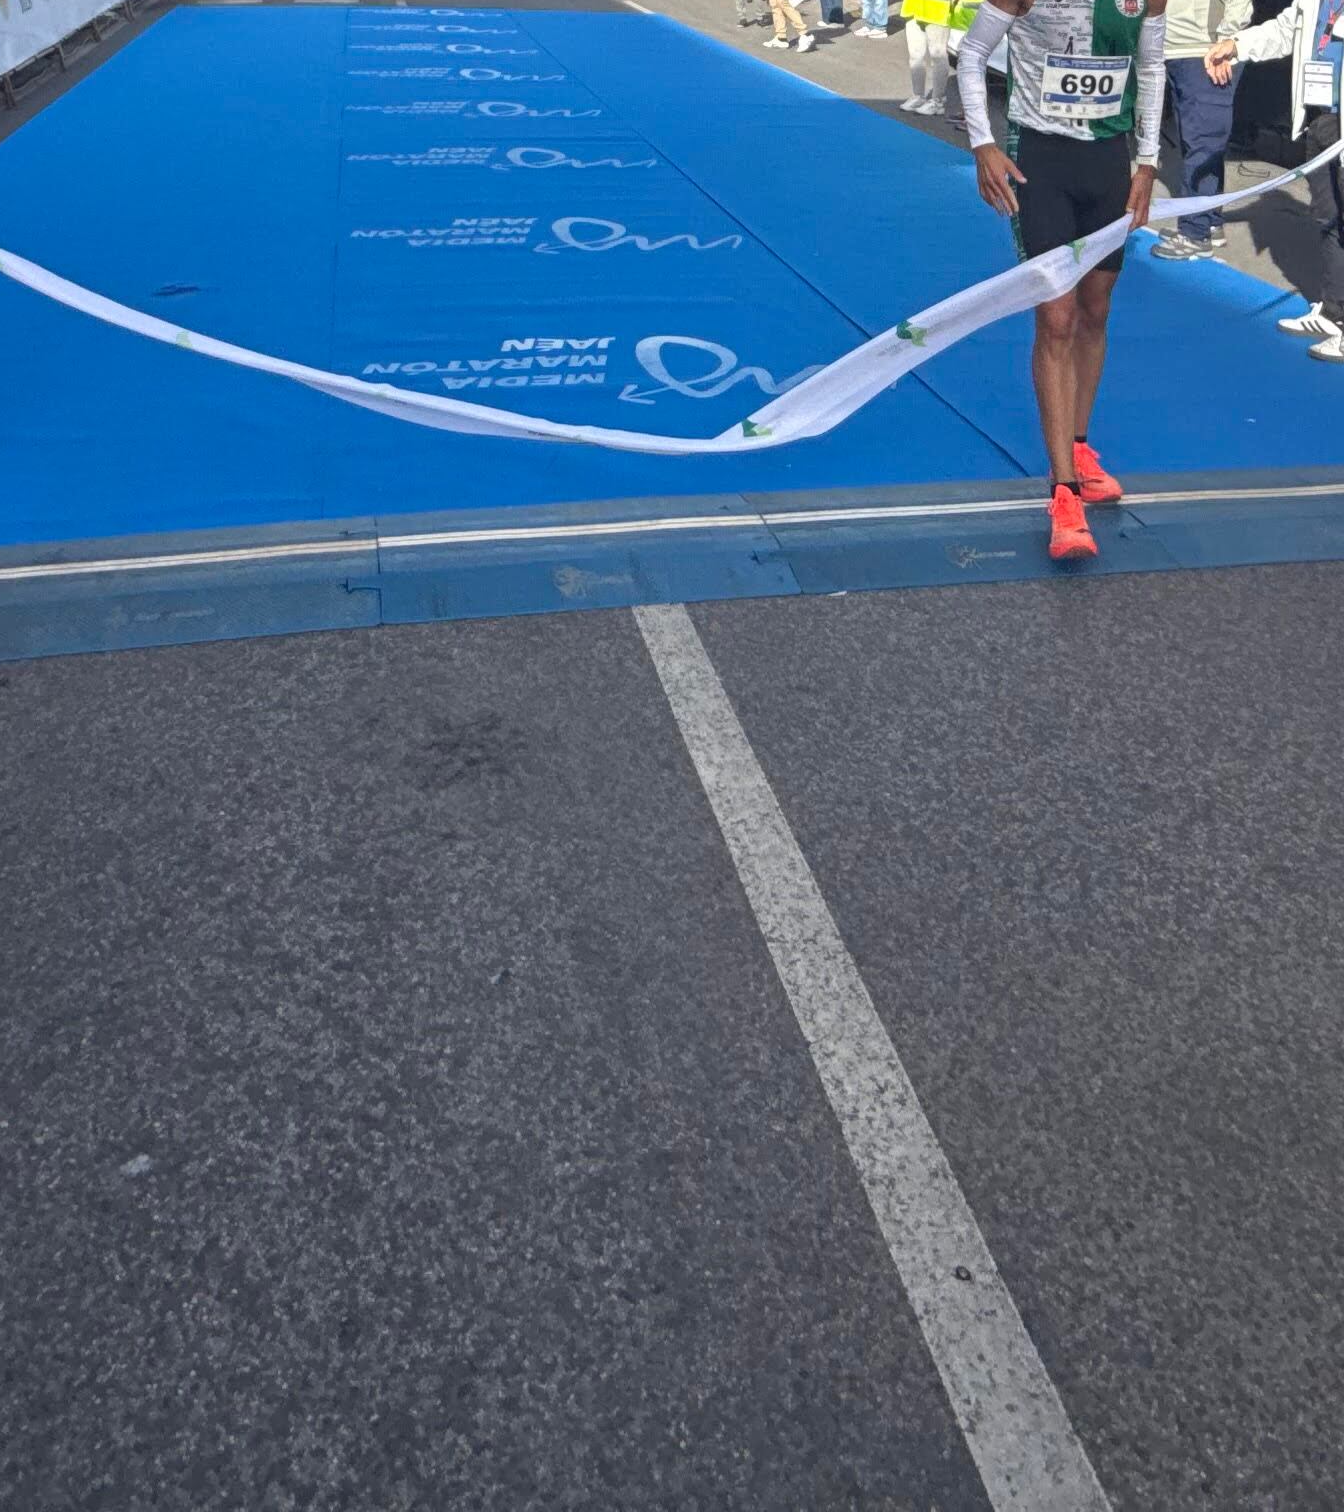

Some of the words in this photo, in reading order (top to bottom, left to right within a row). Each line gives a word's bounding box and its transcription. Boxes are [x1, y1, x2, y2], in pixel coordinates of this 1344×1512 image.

[1061, 74, 1113, 95] 690
[501, 337, 616, 352] JAÉN
[362, 354, 607, 376] MARATÓN
[441, 372, 606, 390] MEDIA
